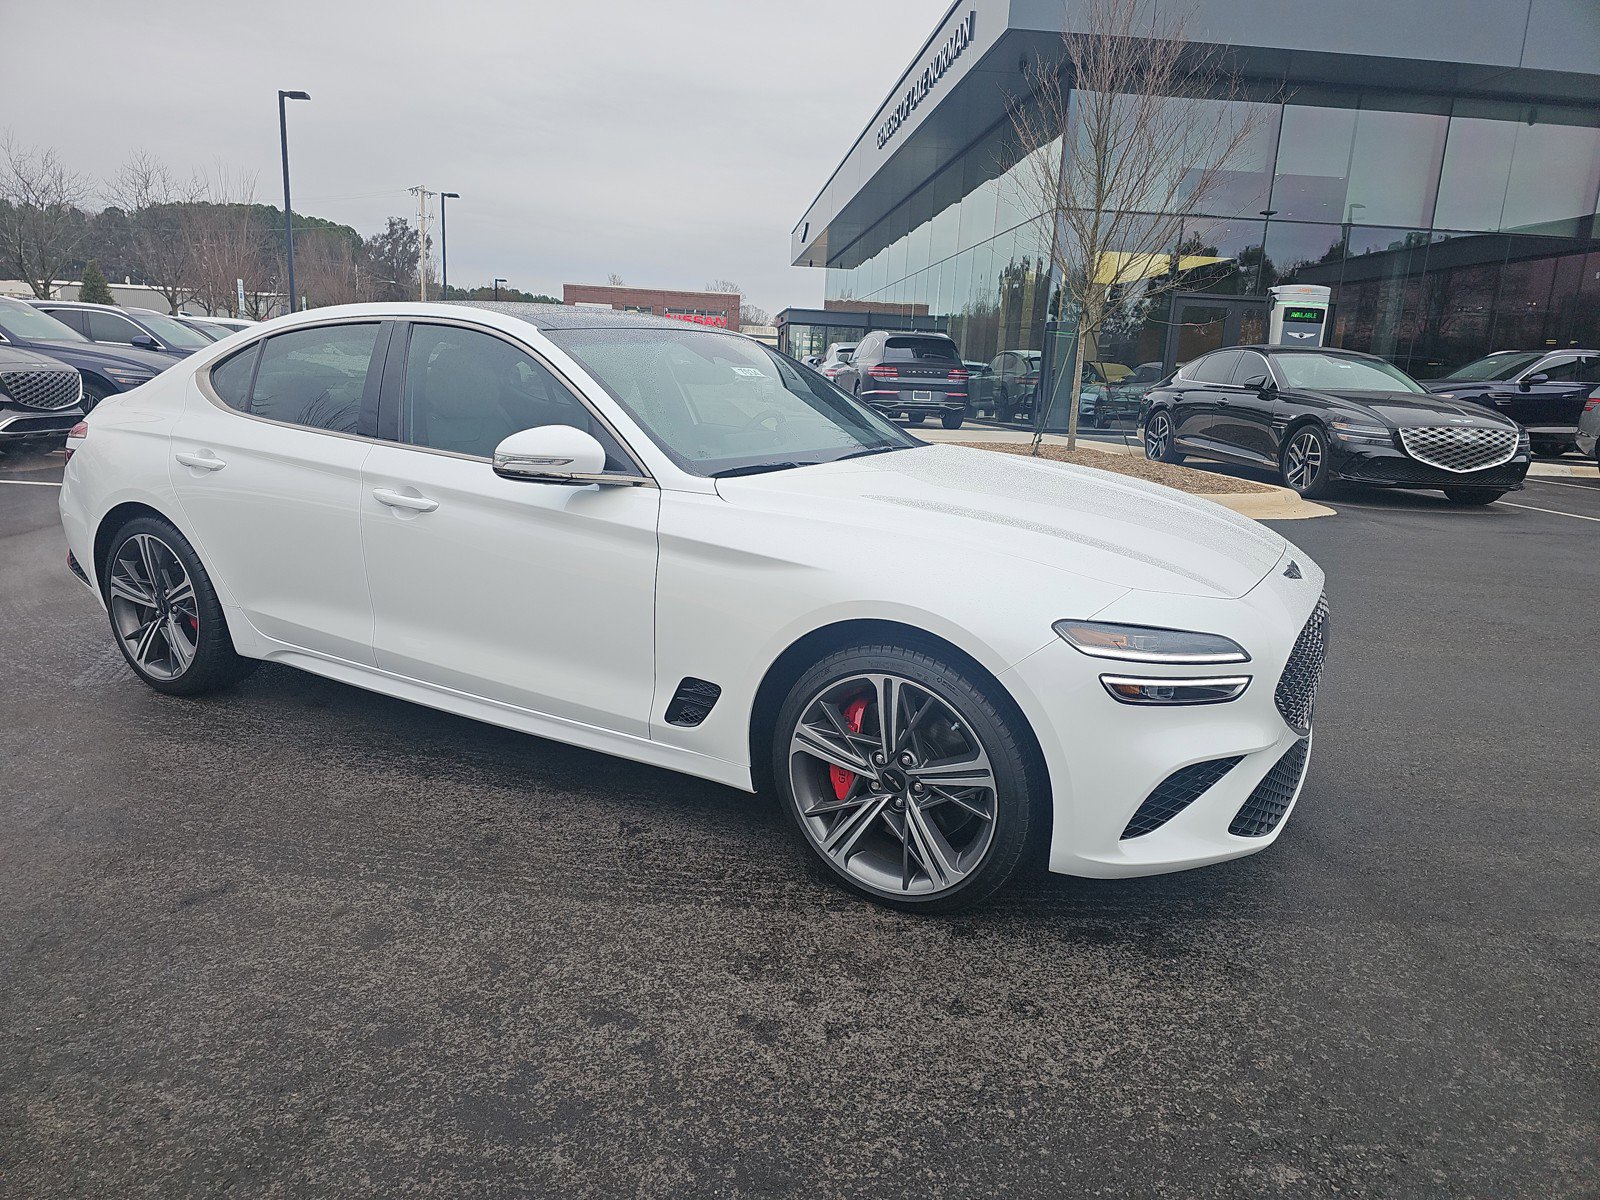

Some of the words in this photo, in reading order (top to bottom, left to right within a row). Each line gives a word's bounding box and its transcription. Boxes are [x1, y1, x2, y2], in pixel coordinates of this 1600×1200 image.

[876, 104, 902, 150] GENESIS
[899, 90, 911, 121] OF
[910, 67, 930, 110] LAKE
[928, 10, 976, 88] NORMAN
[1290, 311, 1318, 319] AVAILABLE
